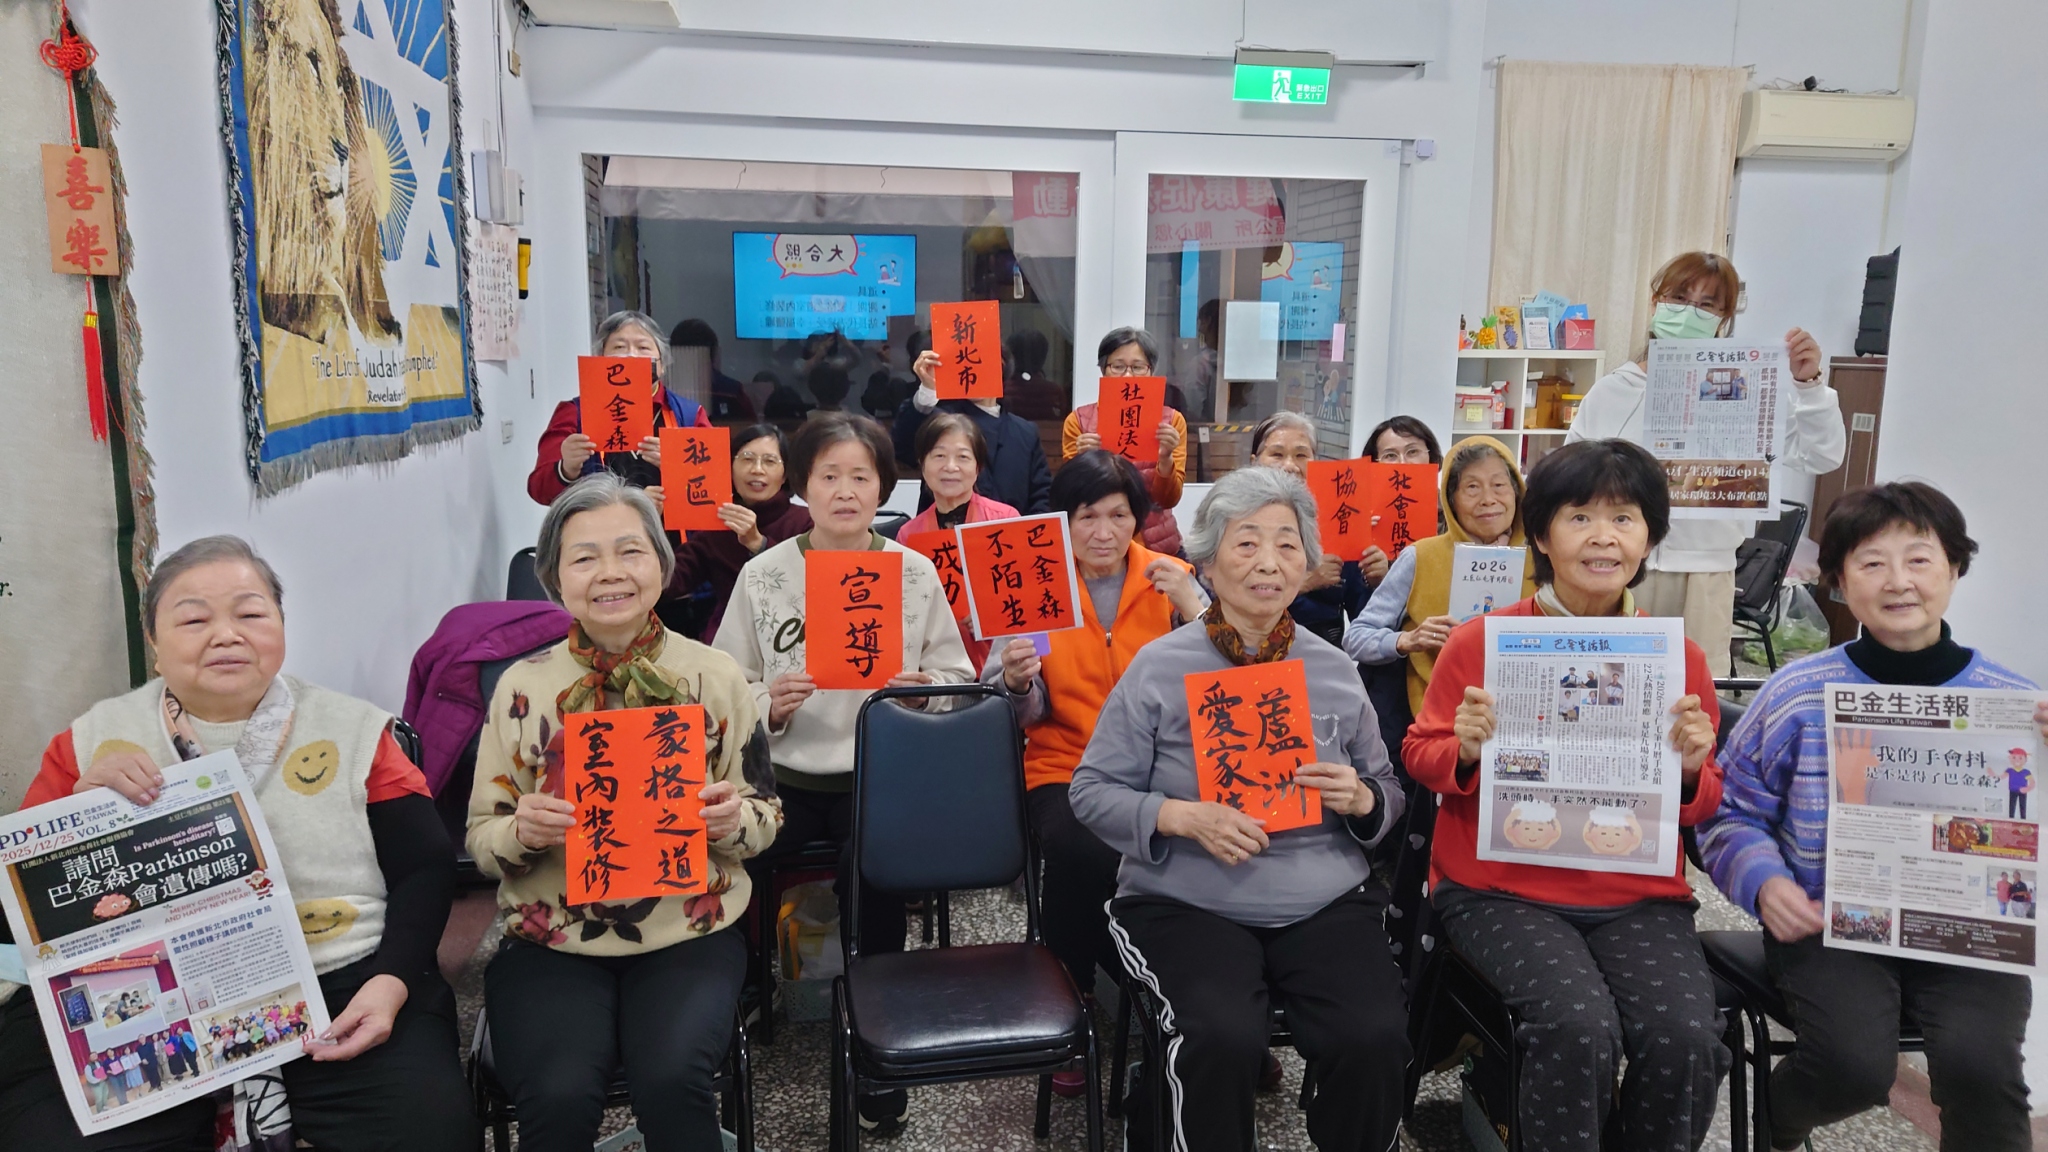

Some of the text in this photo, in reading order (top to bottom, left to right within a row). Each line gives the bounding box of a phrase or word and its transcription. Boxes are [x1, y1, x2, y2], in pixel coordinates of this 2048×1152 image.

[1296, 92, 1322, 100] EXIT
[56, 155, 108, 270] 喜樂
[363, 348, 399, 378] Judah
[951, 312, 982, 395] 新北市
[1749, 349, 1760, 362] 9
[603, 363, 636, 450] 巴金森
[1117, 382, 1145, 460] 社團法人
[683, 438, 716, 507] 社區
[1330, 467, 1361, 535] 協會
[986, 529, 1027, 629] 不陌生
[1026, 523, 1065, 620] 巴金森
[1471, 560, 1507, 572] 2026
[840, 566, 884, 678] 宣導
[1834, 690, 1970, 718] 巴金生活報
[1852, 715, 1933, 727] Parkinson Life Taiwan
[1253, 687, 1309, 820] 蘆洲
[1876, 745, 1987, 769] 我的手會抖
[1866, 765, 2001, 789] 是不是得了巴金森?
[87, 808, 118, 822] TAIWAN
[576, 717, 631, 899] 室內裝修
[643, 708, 705, 889] 蒙格之道
[0, 819, 117, 862] 2025/12/25 VOL. 8
[142, 830, 187, 850] Parkinson's
[187, 821, 215, 835] disease
[172, 828, 216, 848] hereditary?
[47, 835, 237, 908] 巴金森Parkinson
[61, 845, 120, 883] 請問
[132, 852, 249, 907] 會遺傳嗎?
[164, 915, 182, 924] AND
[182, 905, 208, 918] HAPPY
[209, 899, 228, 909] NEW
[169, 886, 242, 915] MERRY CHRISTMAS
[300, 1028, 316, 1046] p1
